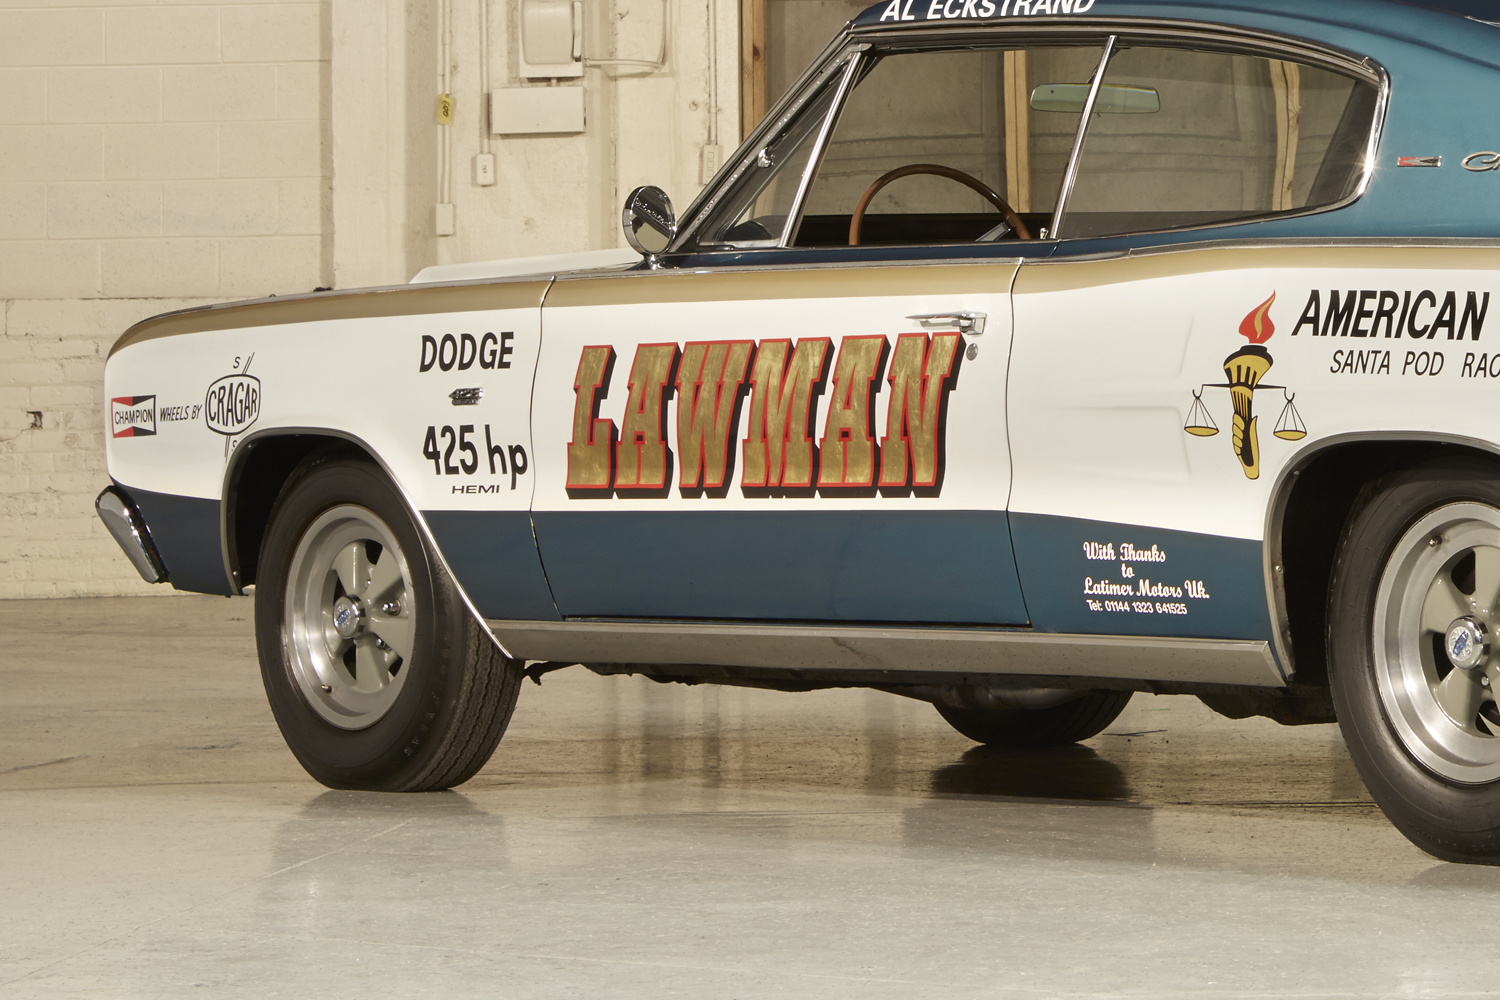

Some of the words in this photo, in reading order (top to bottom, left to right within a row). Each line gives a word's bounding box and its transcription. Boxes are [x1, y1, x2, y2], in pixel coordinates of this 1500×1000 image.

[1290, 289, 1490, 341] AMERICAN
[233, 356, 241, 369] S
[419, 331, 514, 373] DODGE
[1329, 349, 1391, 375] SANTA
[1402, 351, 1444, 377] POD
[159, 405, 190, 422] WHEELS
[191, 404, 203, 420] BY
[208, 382, 258, 427] CRAGAR
[565, 331, 966, 499] LAWMAN
[114, 408, 153, 425] CHAMPION
[423, 424, 479, 476] 425
[484, 424, 528, 490] hp
[451, 485, 500, 494] HEMI
[1083, 541, 1116, 561] With
[1119, 542, 1166, 562] Thanks
[1121, 563, 1135, 578] to
[1083, 577, 1134, 596] Latimer
[1136, 579, 1182, 598] Motors
[1184, 579, 1210, 599] Uk.
[1086, 599, 1103, 611] Tel:
[1104, 600, 1130, 612] 01144
[1132, 601, 1153, 613] 1323
[1155, 602, 1188, 614] 641525
